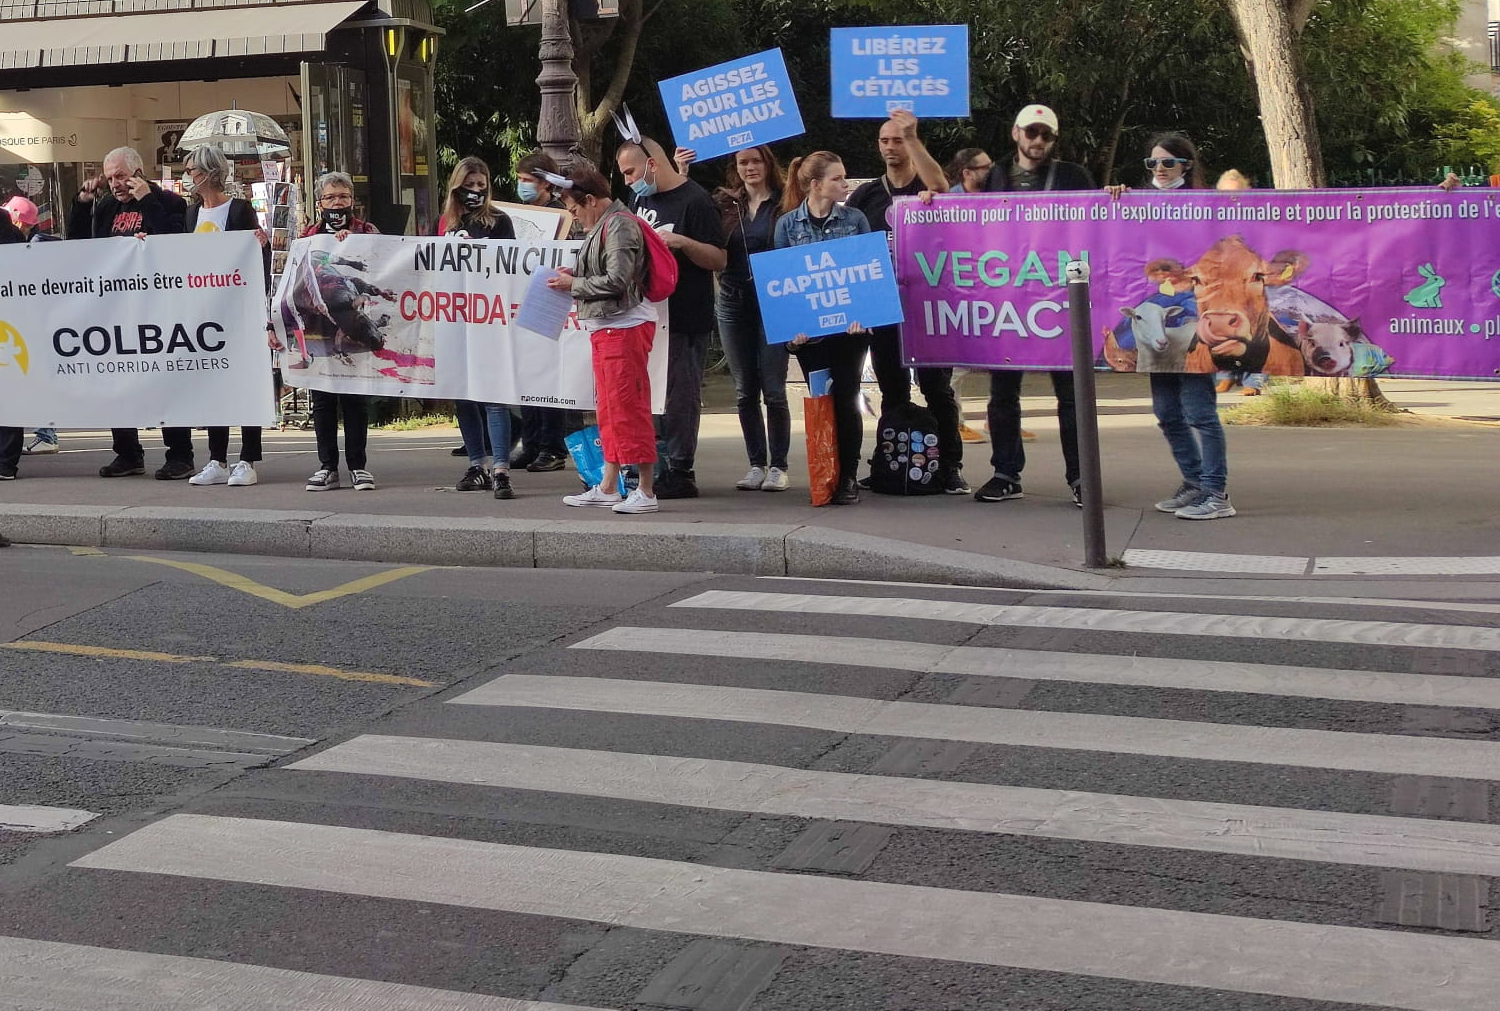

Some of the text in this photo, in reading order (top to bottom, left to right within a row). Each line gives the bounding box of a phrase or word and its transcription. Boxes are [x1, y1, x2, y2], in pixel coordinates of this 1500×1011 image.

[852, 35, 946, 55] LIBÉREZ
[879, 58, 919, 75] LES
[682, 62, 768, 101] AGISSEZ
[850, 76, 949, 97] CÉTACÉS
[679, 81, 779, 122] POUR LES
[689, 100, 785, 141] ANIMAUX
[27, 137, 39, 145] DE
[41, 136, 66, 144] PARIS
[903, 204, 977, 225] Association
[981, 206, 1012, 225] pour
[1016, 203, 1086, 223] l'abolition
[1090, 203, 1108, 221] de
[1112, 202, 1213, 224] l'exploitation
[1217, 202, 1281, 221] animale
[1285, 203, 1302, 221] et
[1306, 204, 1343, 224] pour
[1347, 202, 1362, 221] la
[1367, 200, 1453, 223] protection
[1458, 200, 1479, 219] de
[414, 242, 436, 271] NI
[439, 242, 490, 279] ART,
[496, 244, 519, 275] NI
[804, 251, 836, 272] LA
[915, 250, 1089, 288] VEGAN
[18, 282, 37, 297] ne
[41, 276, 95, 296] devrait
[99, 273, 149, 297] jamais
[153, 273, 183, 290] être
[187, 269, 247, 289] torturé.
[767, 258, 884, 297] CAPTIVITÉ
[400, 290, 507, 326] CORRIDA
[806, 288, 851, 310] TUE
[924, 300, 1091, 338] IMPAC
[1389, 314, 1464, 335] animaux
[52, 321, 226, 358] COLBAC
[56, 357, 230, 375] ANTI CORRIDA BÉZIERS
